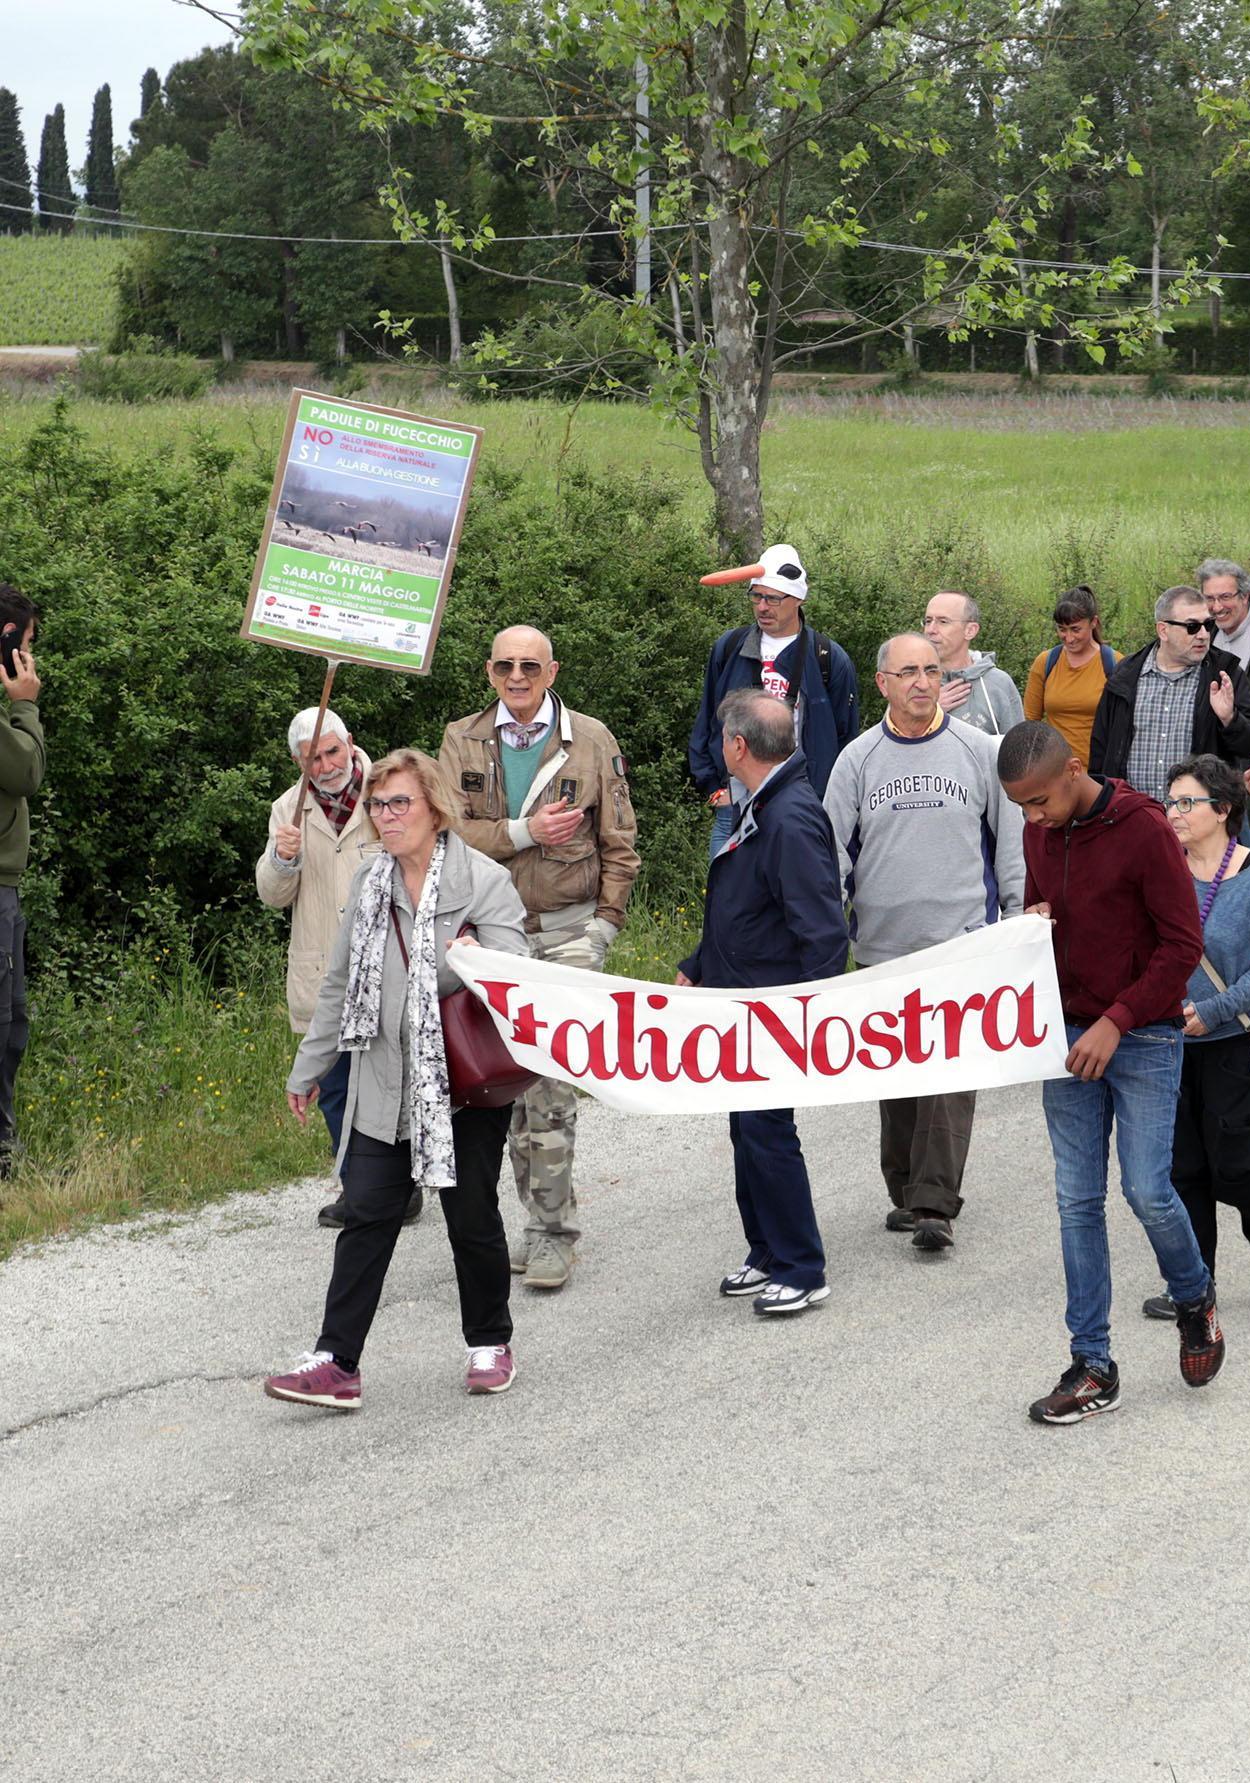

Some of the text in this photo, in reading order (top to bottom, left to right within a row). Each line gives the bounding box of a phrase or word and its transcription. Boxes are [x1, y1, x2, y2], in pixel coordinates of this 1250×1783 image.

[303, 425, 334, 446] NO
[310, 406, 463, 450] PADULE DI FUCECCHIO
[339, 443, 364, 454] DELLA
[342, 435, 361, 445] ALLO
[328, 560, 385, 582] MARCIA
[282, 564, 421, 602] SABATO 11 MAGGIO
[763, 677, 789, 691] PEN
[869, 774, 969, 811] GEORGETOWN
[896, 801, 941, 810] UNIVERSITY
